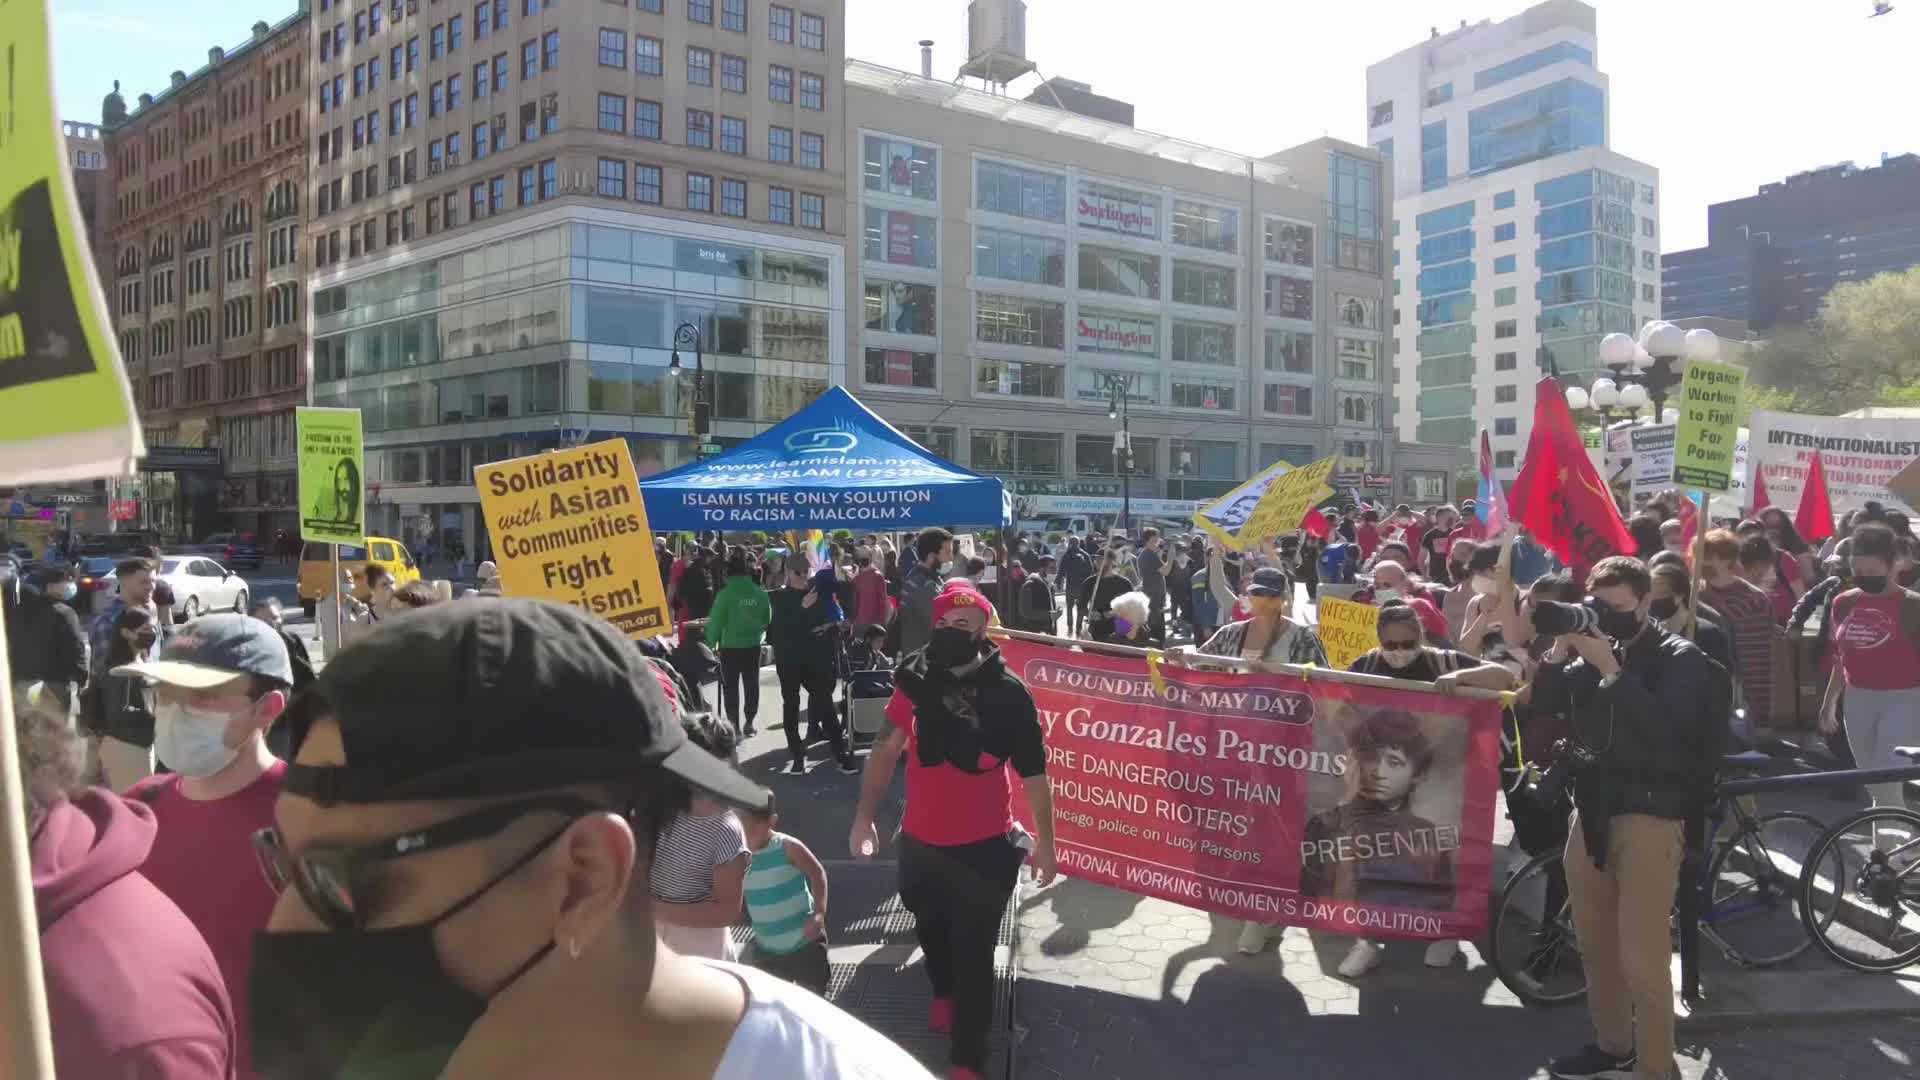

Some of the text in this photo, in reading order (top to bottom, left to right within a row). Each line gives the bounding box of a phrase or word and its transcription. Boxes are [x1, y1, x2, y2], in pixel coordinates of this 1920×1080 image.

[1689, 409, 1704, 422] to
[489, 452, 619, 496] Solidarity
[1797, 450, 1908, 471] REOLUTIONAR
[59, 495, 94, 503] HASE
[499, 484, 631, 530] with Asian
[682, 490, 931, 506] ISLAM IS THE ONLY SOLUTION
[703, 509, 724, 521] TO
[730, 508, 795, 521] RACISM
[810, 507, 894, 520] MALCOLM
[900, 507, 911, 519] X
[502, 514, 640, 559] Communities
[542, 552, 613, 589] Fight
[570, 579, 642, 613] ism!
[1034, 666, 1302, 716] A FOUNDER OF MAY DAY
[1065, 707, 1207, 757] Gonzales
[1216, 728, 1348, 776] Parsons
[1045, 745, 1281, 806] ORE DANGEROUS THAN
[1049, 776, 1148, 815] HOUSAND
[1055, 809, 1262, 864] hicago police on Lucy Parsons
[1301, 825, 1463, 865] PRESENTE!
[1055, 848, 1442, 934] NATIONAL WORKING WOMEN'S DAY COALITION
